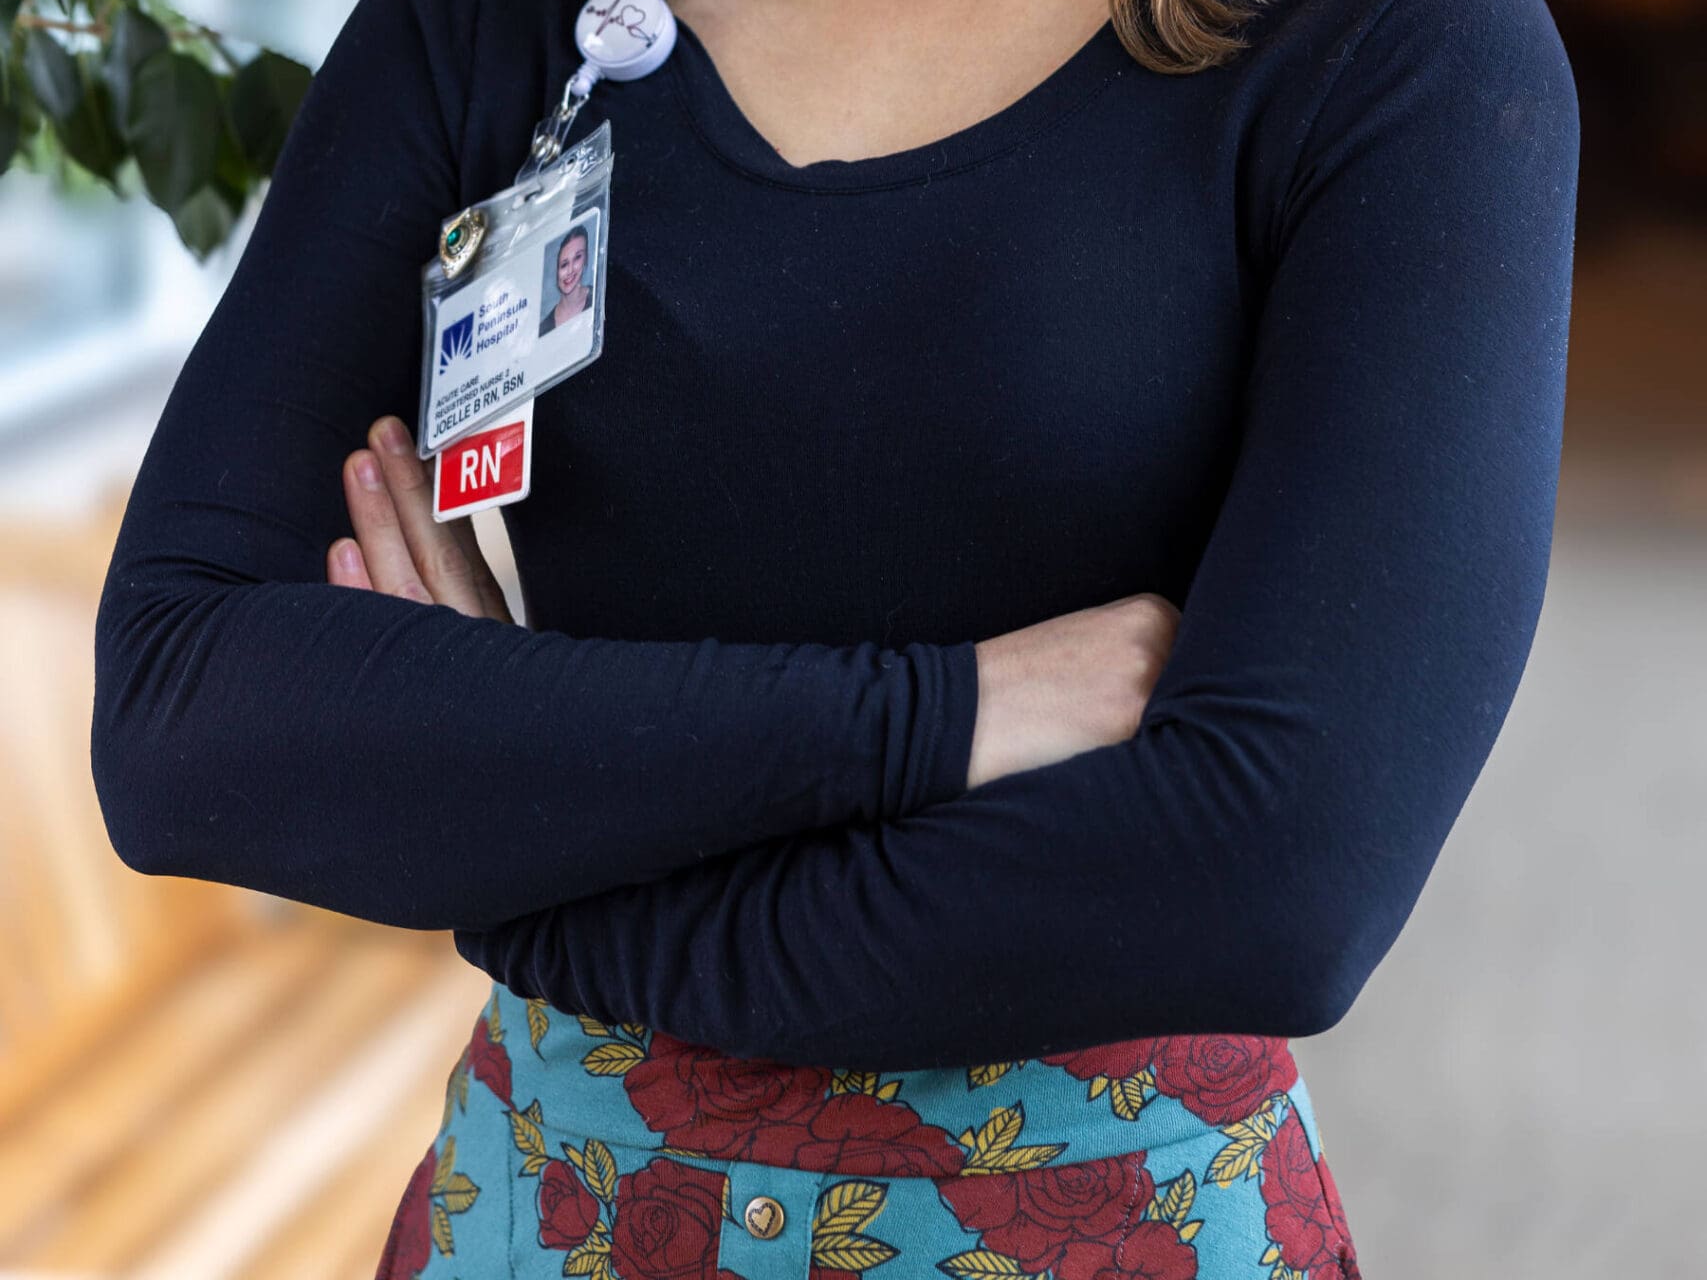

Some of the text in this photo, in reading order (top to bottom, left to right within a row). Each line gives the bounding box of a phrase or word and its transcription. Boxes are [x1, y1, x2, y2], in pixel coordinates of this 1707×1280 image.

[476, 318, 518, 354] Hospital
[477, 297, 528, 336] Peninsula
[433, 370, 524, 438] JOELLE B RN, BSN
[435, 388, 478, 418] REGISTERED
[479, 371, 504, 392] NURSE
[436, 374, 480, 407] ACUTE CARE
[460, 441, 502, 493] RN
